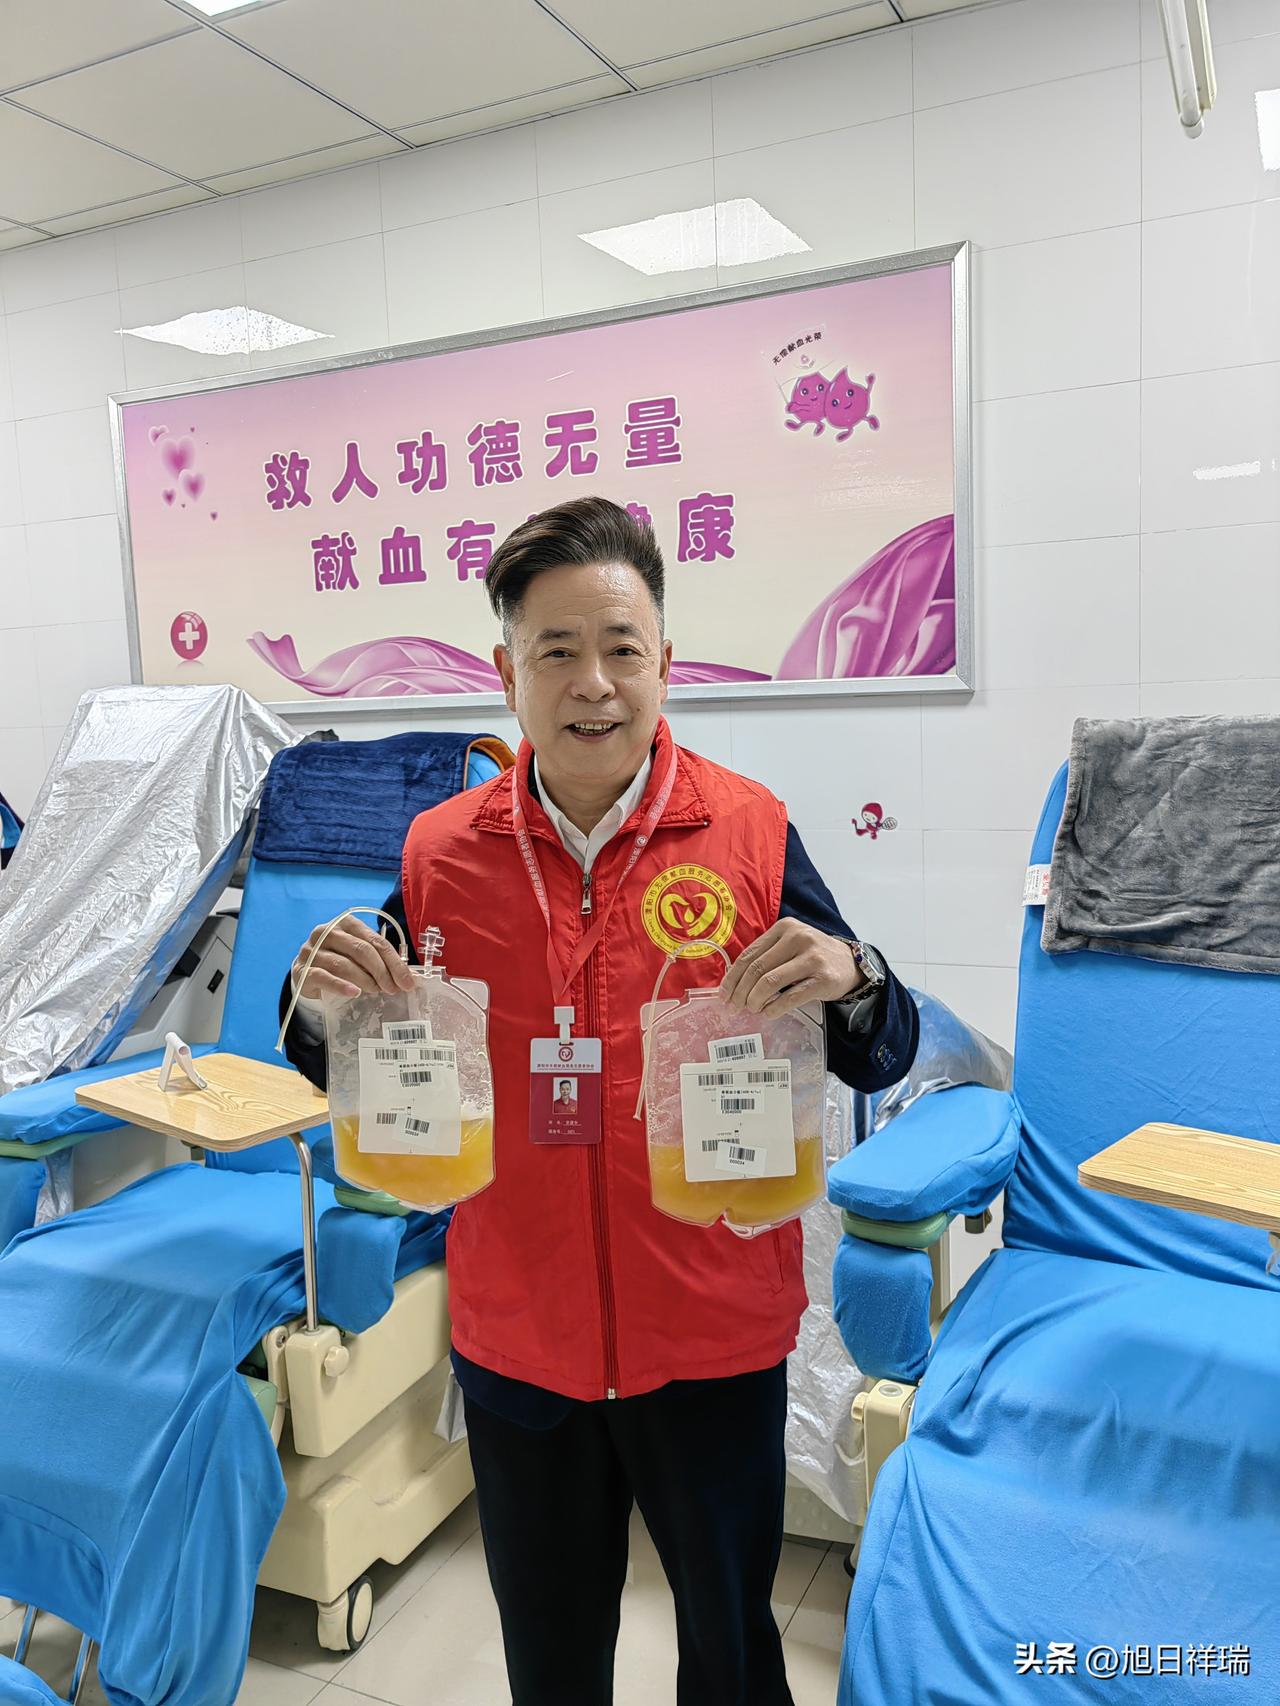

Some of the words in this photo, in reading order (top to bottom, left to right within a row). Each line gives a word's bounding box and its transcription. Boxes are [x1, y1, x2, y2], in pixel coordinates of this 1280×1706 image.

[264, 396, 682, 511] 救人功德无量
[311, 492, 736, 592] 献血有康
